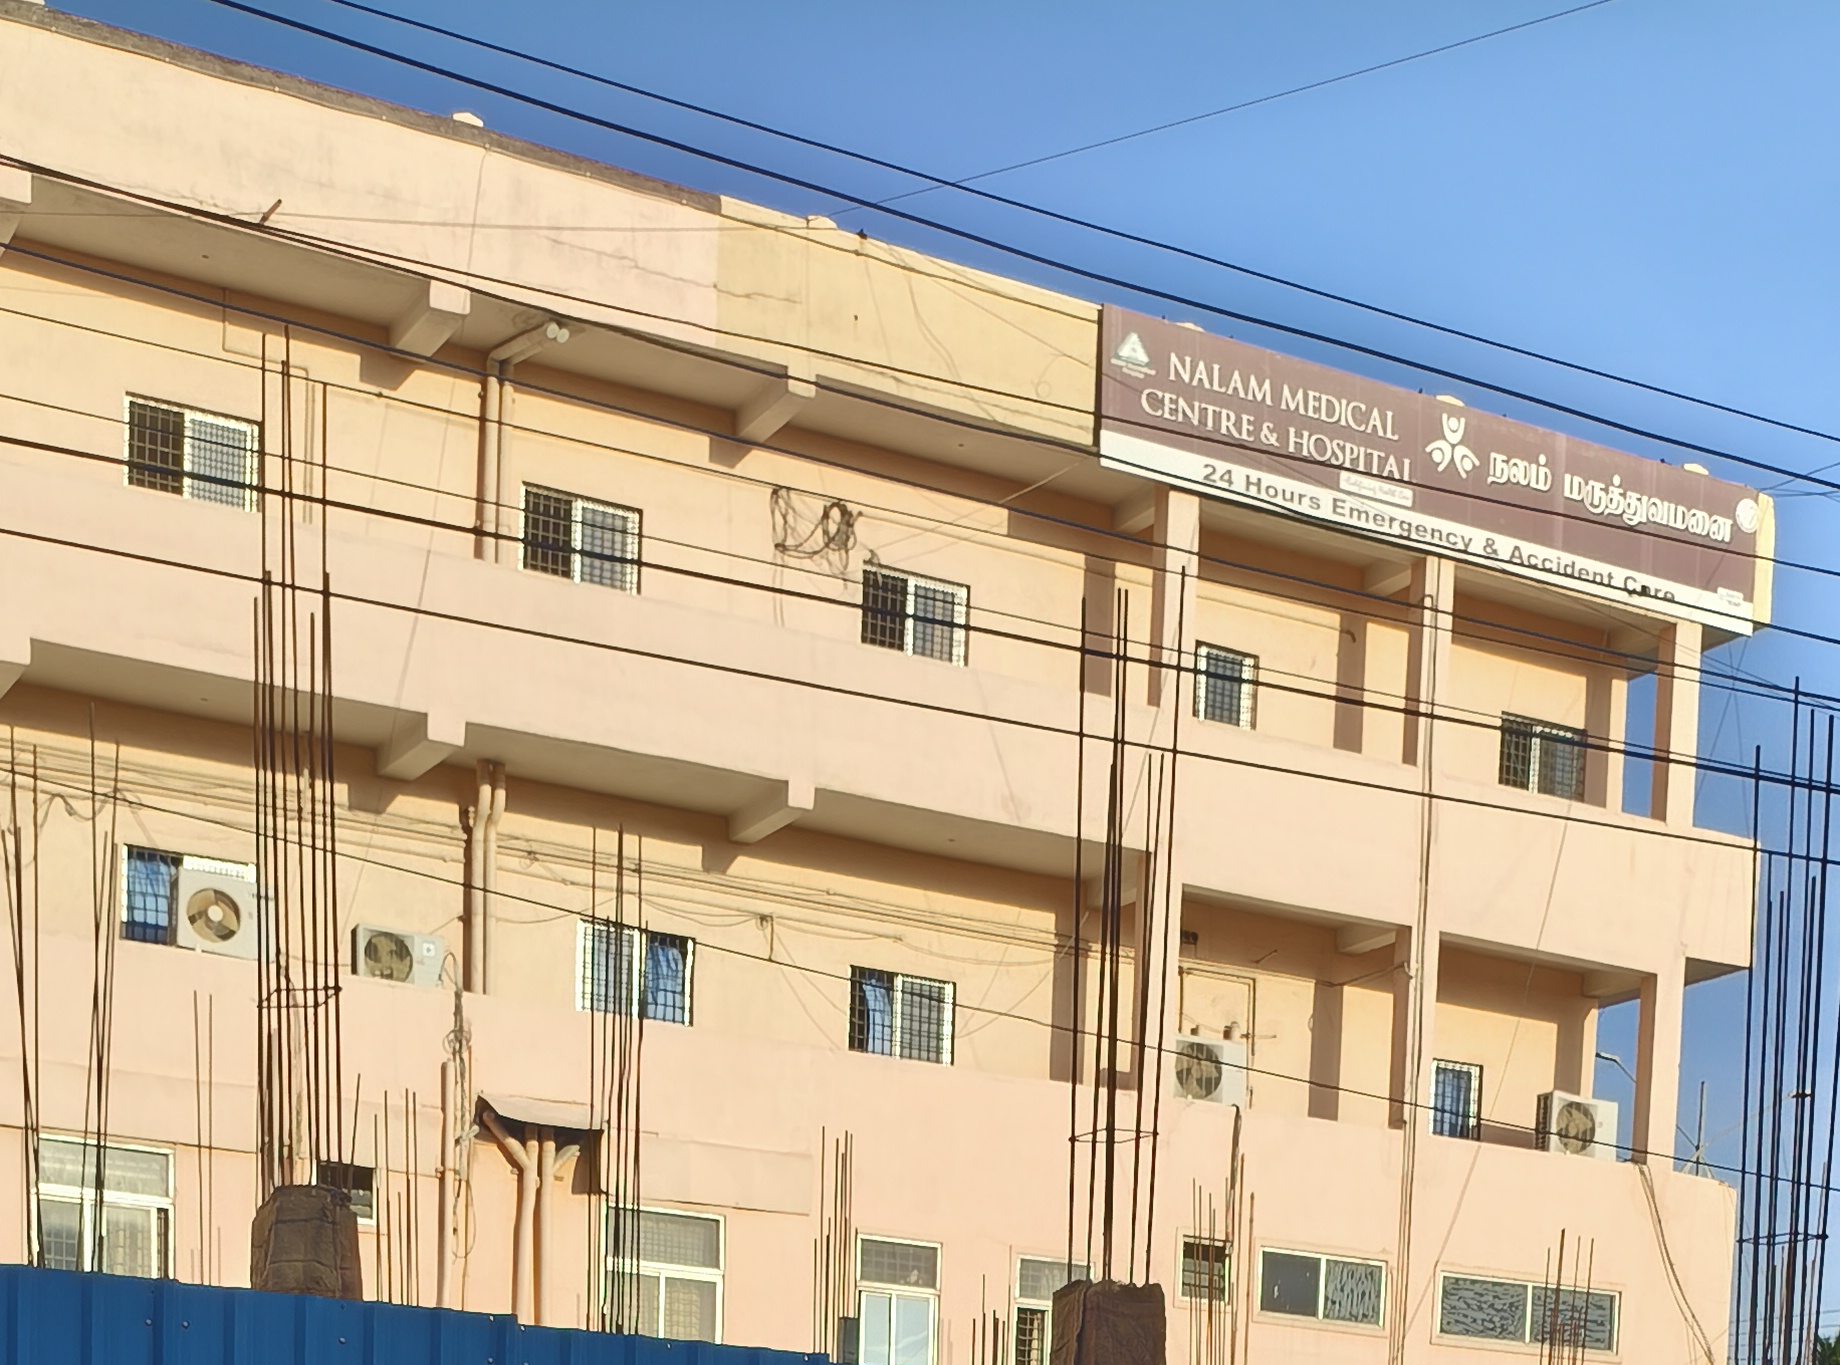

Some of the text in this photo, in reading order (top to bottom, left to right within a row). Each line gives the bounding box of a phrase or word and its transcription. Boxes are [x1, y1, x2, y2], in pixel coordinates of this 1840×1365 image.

[1141, 388, 1413, 482] CENTRE & HOSPITAL
[1169, 352, 1273, 406] NALAM
[1281, 384, 1399, 440] MEDICAL
[1487, 452, 1552, 492] நலம்
[1203, 464, 1235, 488] 24
[1246, 475, 1322, 511] Hours
[1332, 498, 1473, 551] Emergency
[1483, 538, 1499, 557] &
[1509, 545, 1615, 588] Accident
